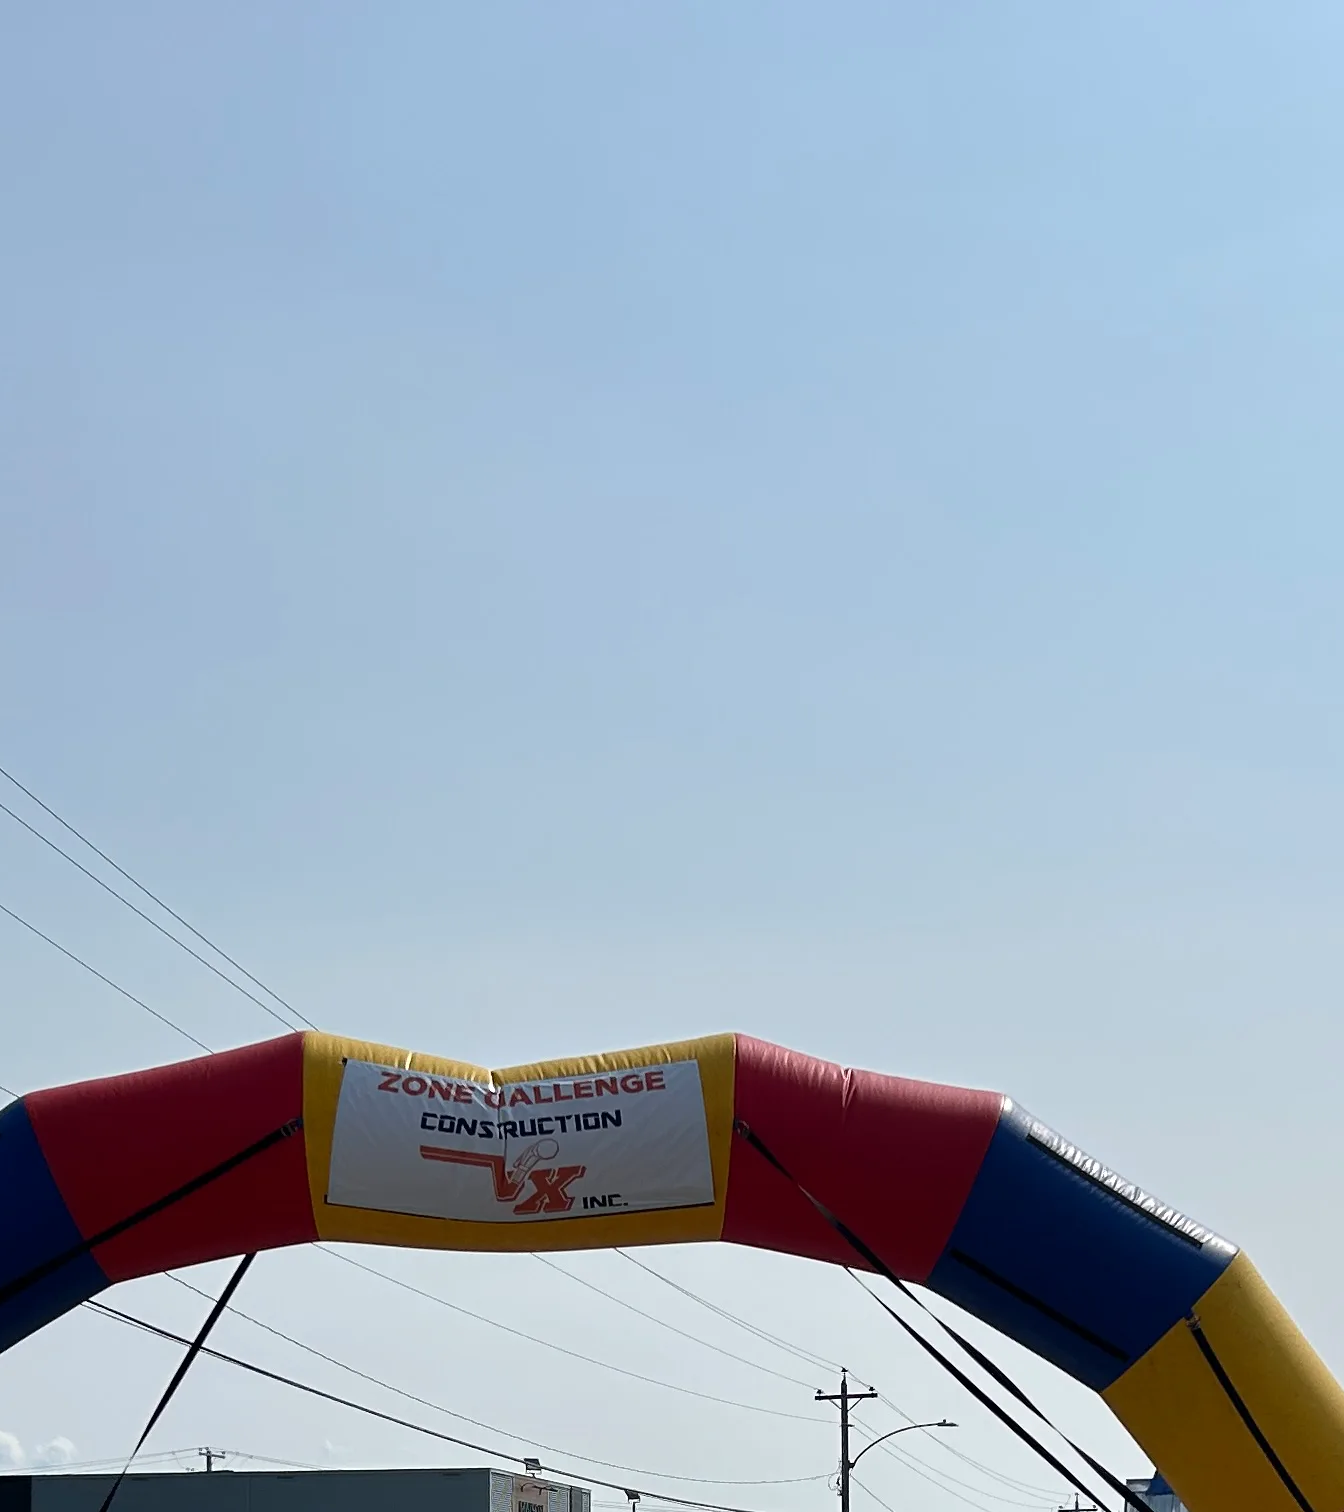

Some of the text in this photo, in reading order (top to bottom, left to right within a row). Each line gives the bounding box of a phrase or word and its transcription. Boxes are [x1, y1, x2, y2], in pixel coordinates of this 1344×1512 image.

[377, 1071, 475, 1104] ZONE
[420, 1109, 623, 1140] CONSTRUCTION
[582, 1193, 629, 1209] INC.
